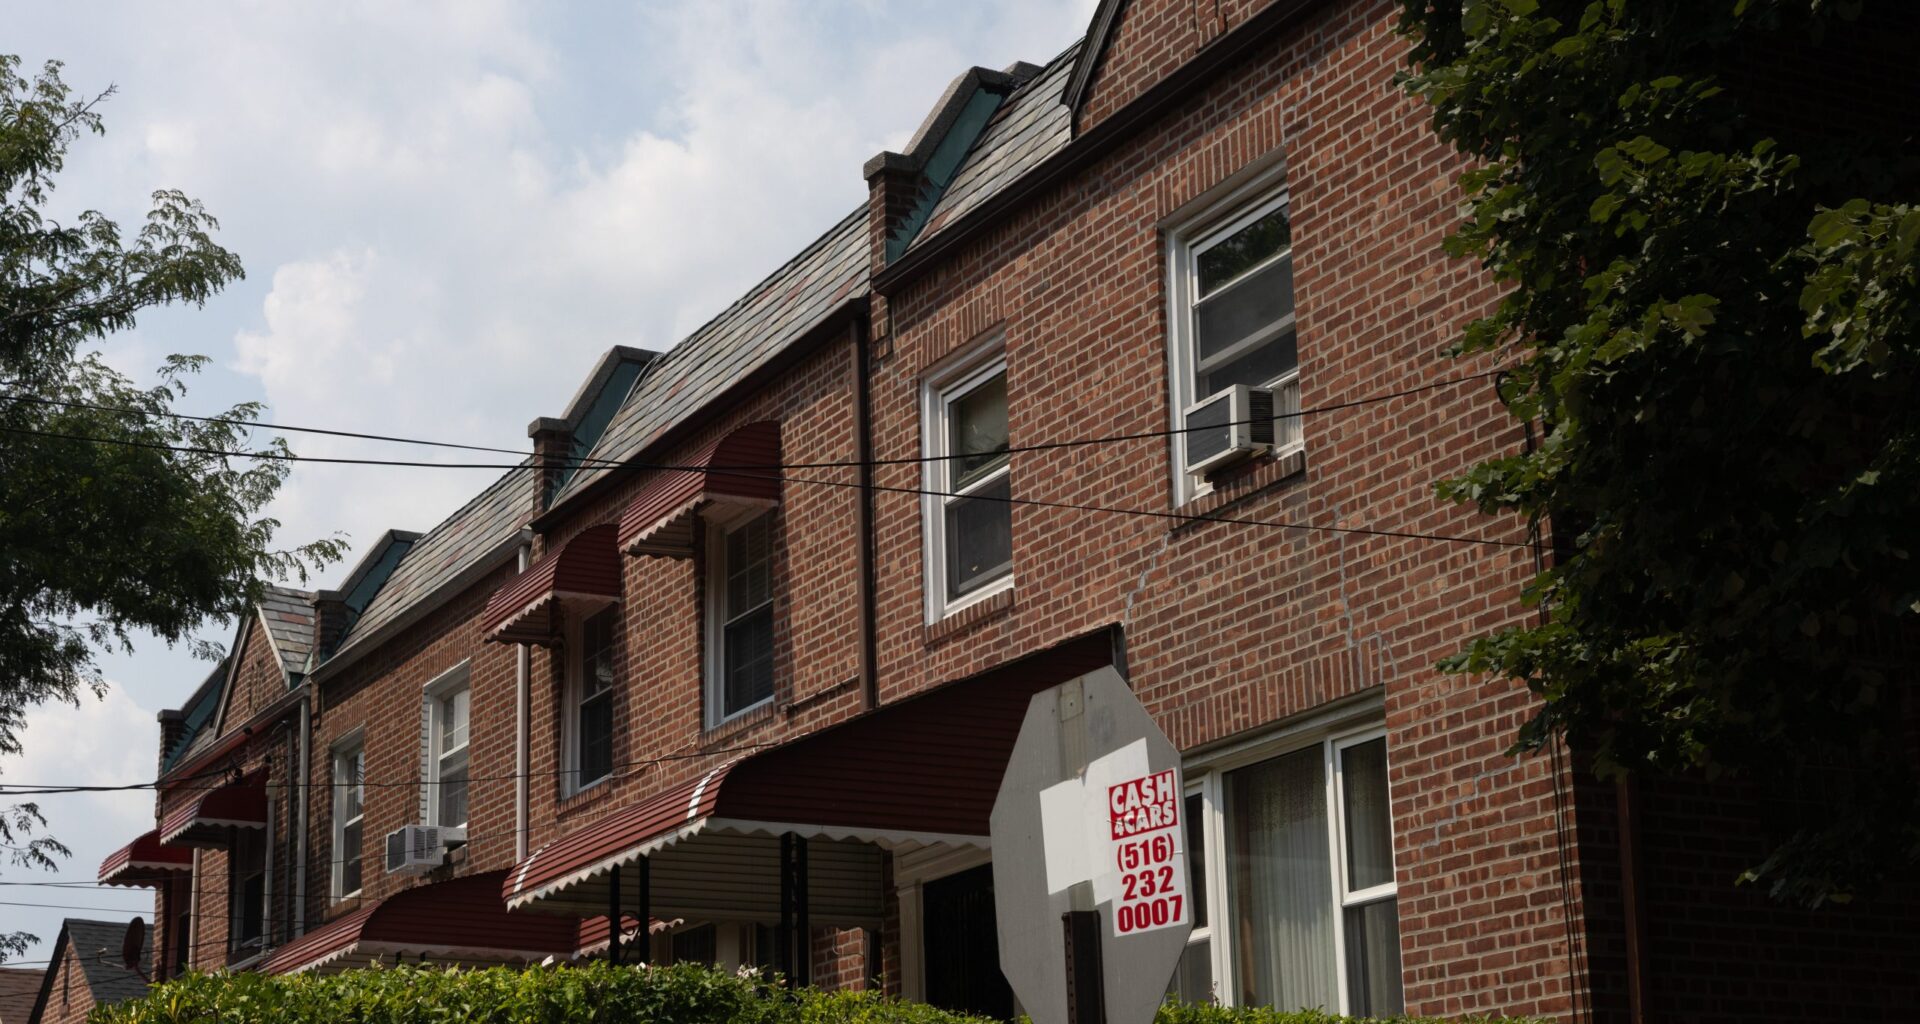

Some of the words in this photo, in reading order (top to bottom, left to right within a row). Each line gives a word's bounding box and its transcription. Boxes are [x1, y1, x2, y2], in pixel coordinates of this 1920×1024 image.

[1117, 833, 1174, 872] (516)
[1122, 865, 1174, 902] 232
[1118, 894, 1182, 933] 0007
